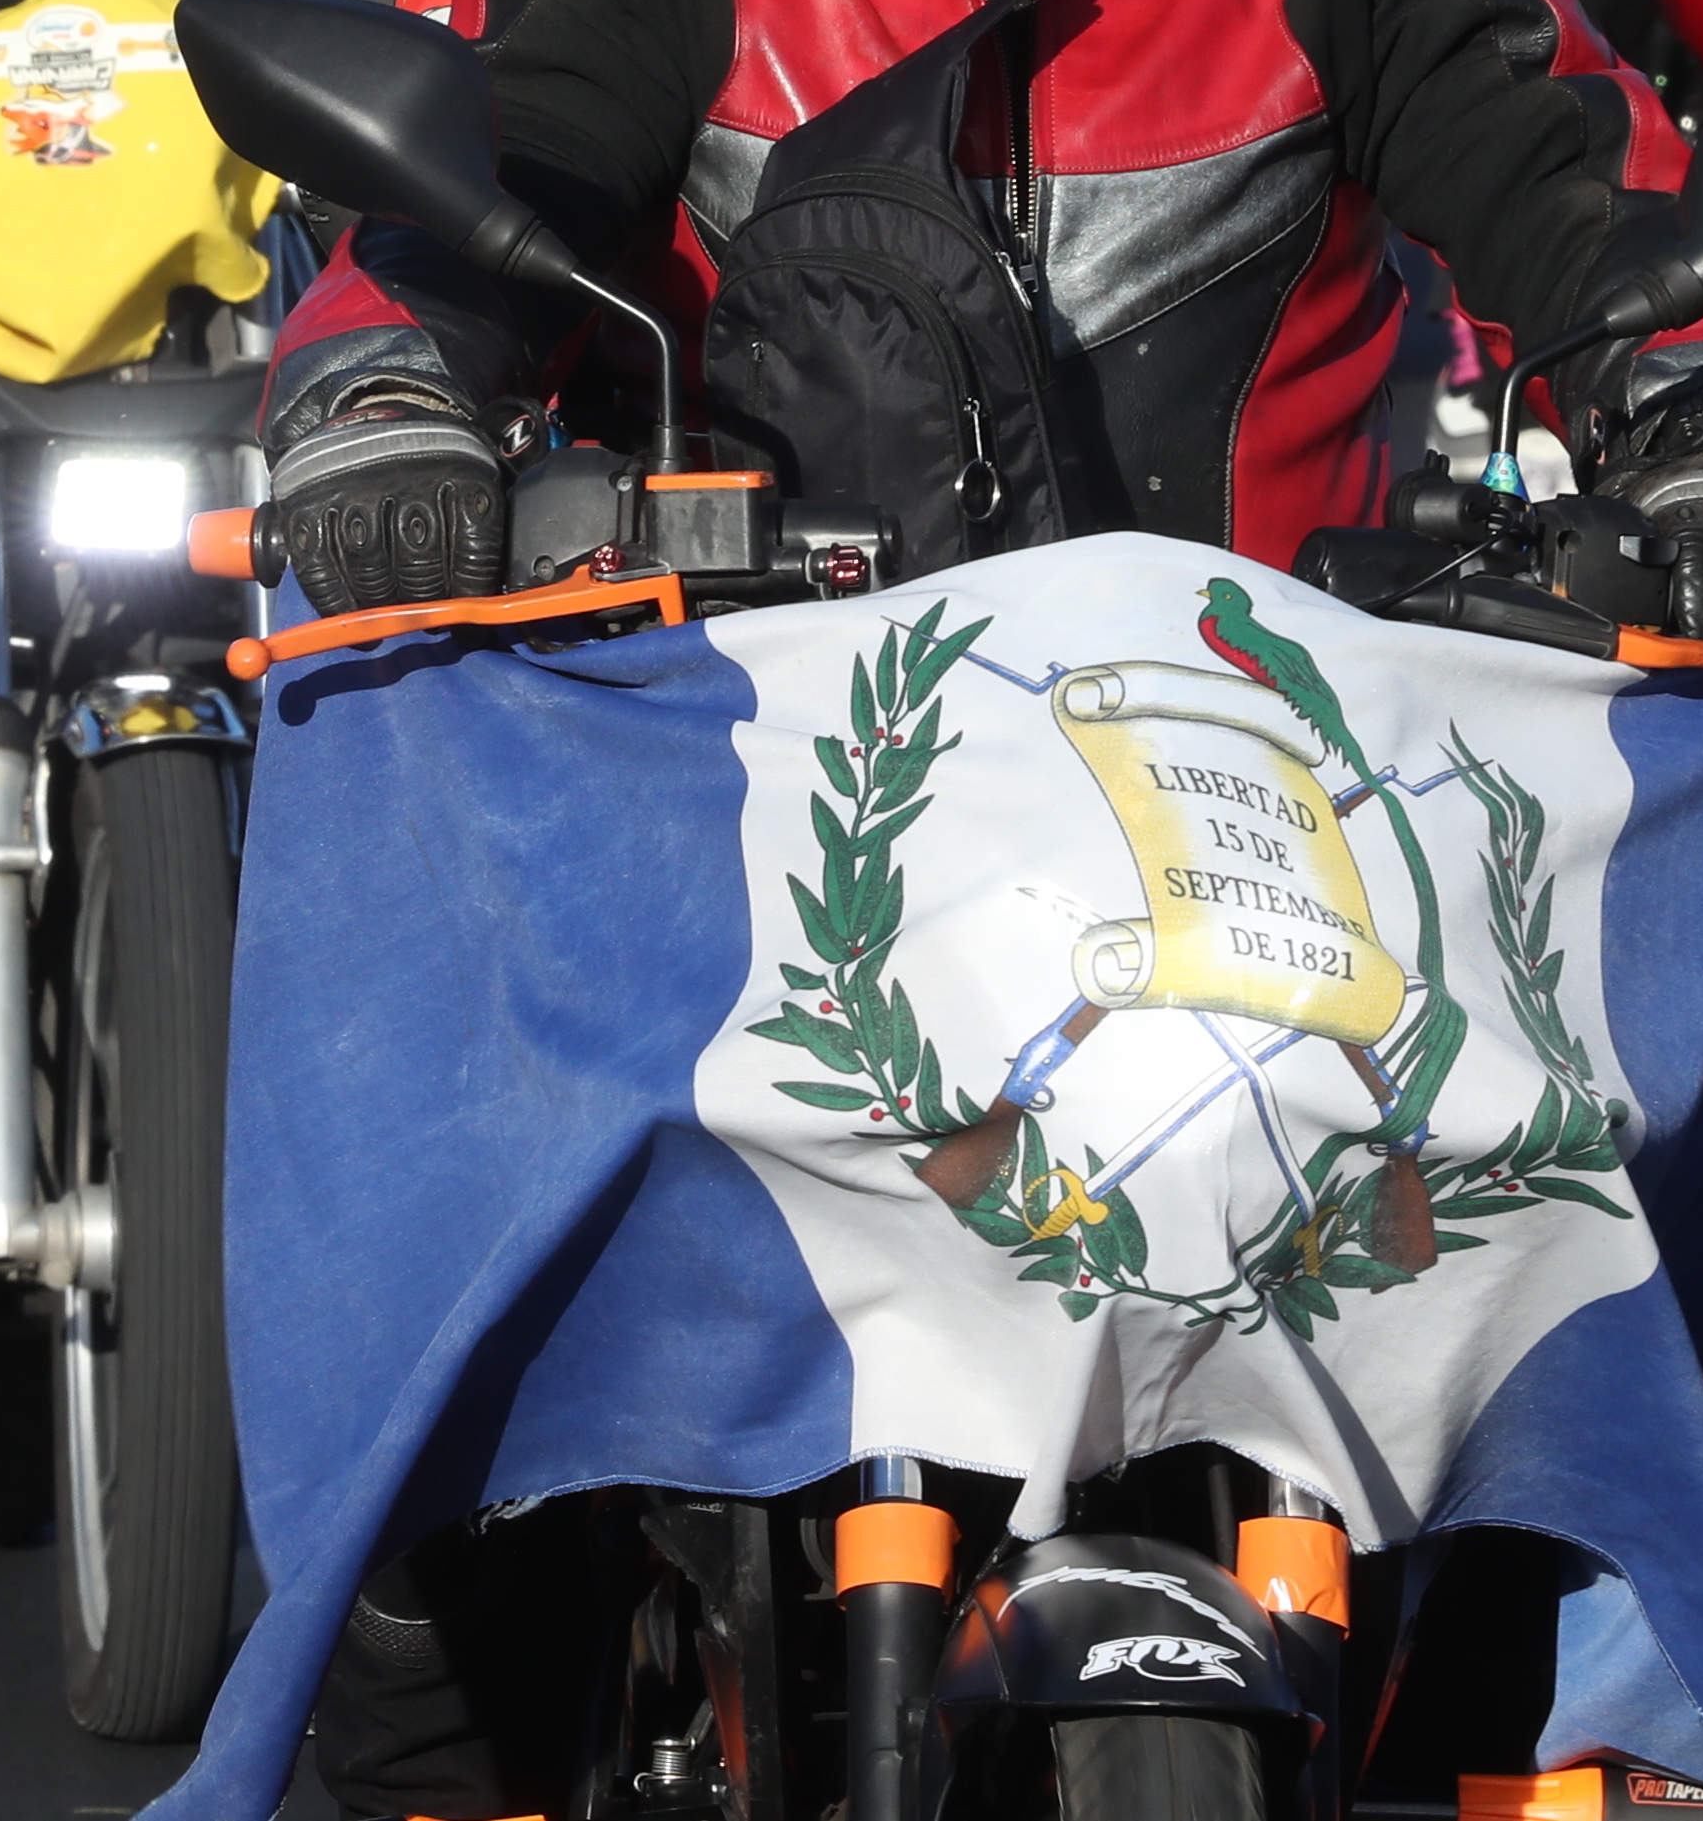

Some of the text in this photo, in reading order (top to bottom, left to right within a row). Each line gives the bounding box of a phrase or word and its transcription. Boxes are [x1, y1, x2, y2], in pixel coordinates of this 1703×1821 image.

[1144, 763, 1318, 834] LIBERTAD
[1206, 818, 1295, 874] 15 DE
[1227, 925, 1356, 983] DE 1821
[1078, 1635, 1247, 1688] FOX
